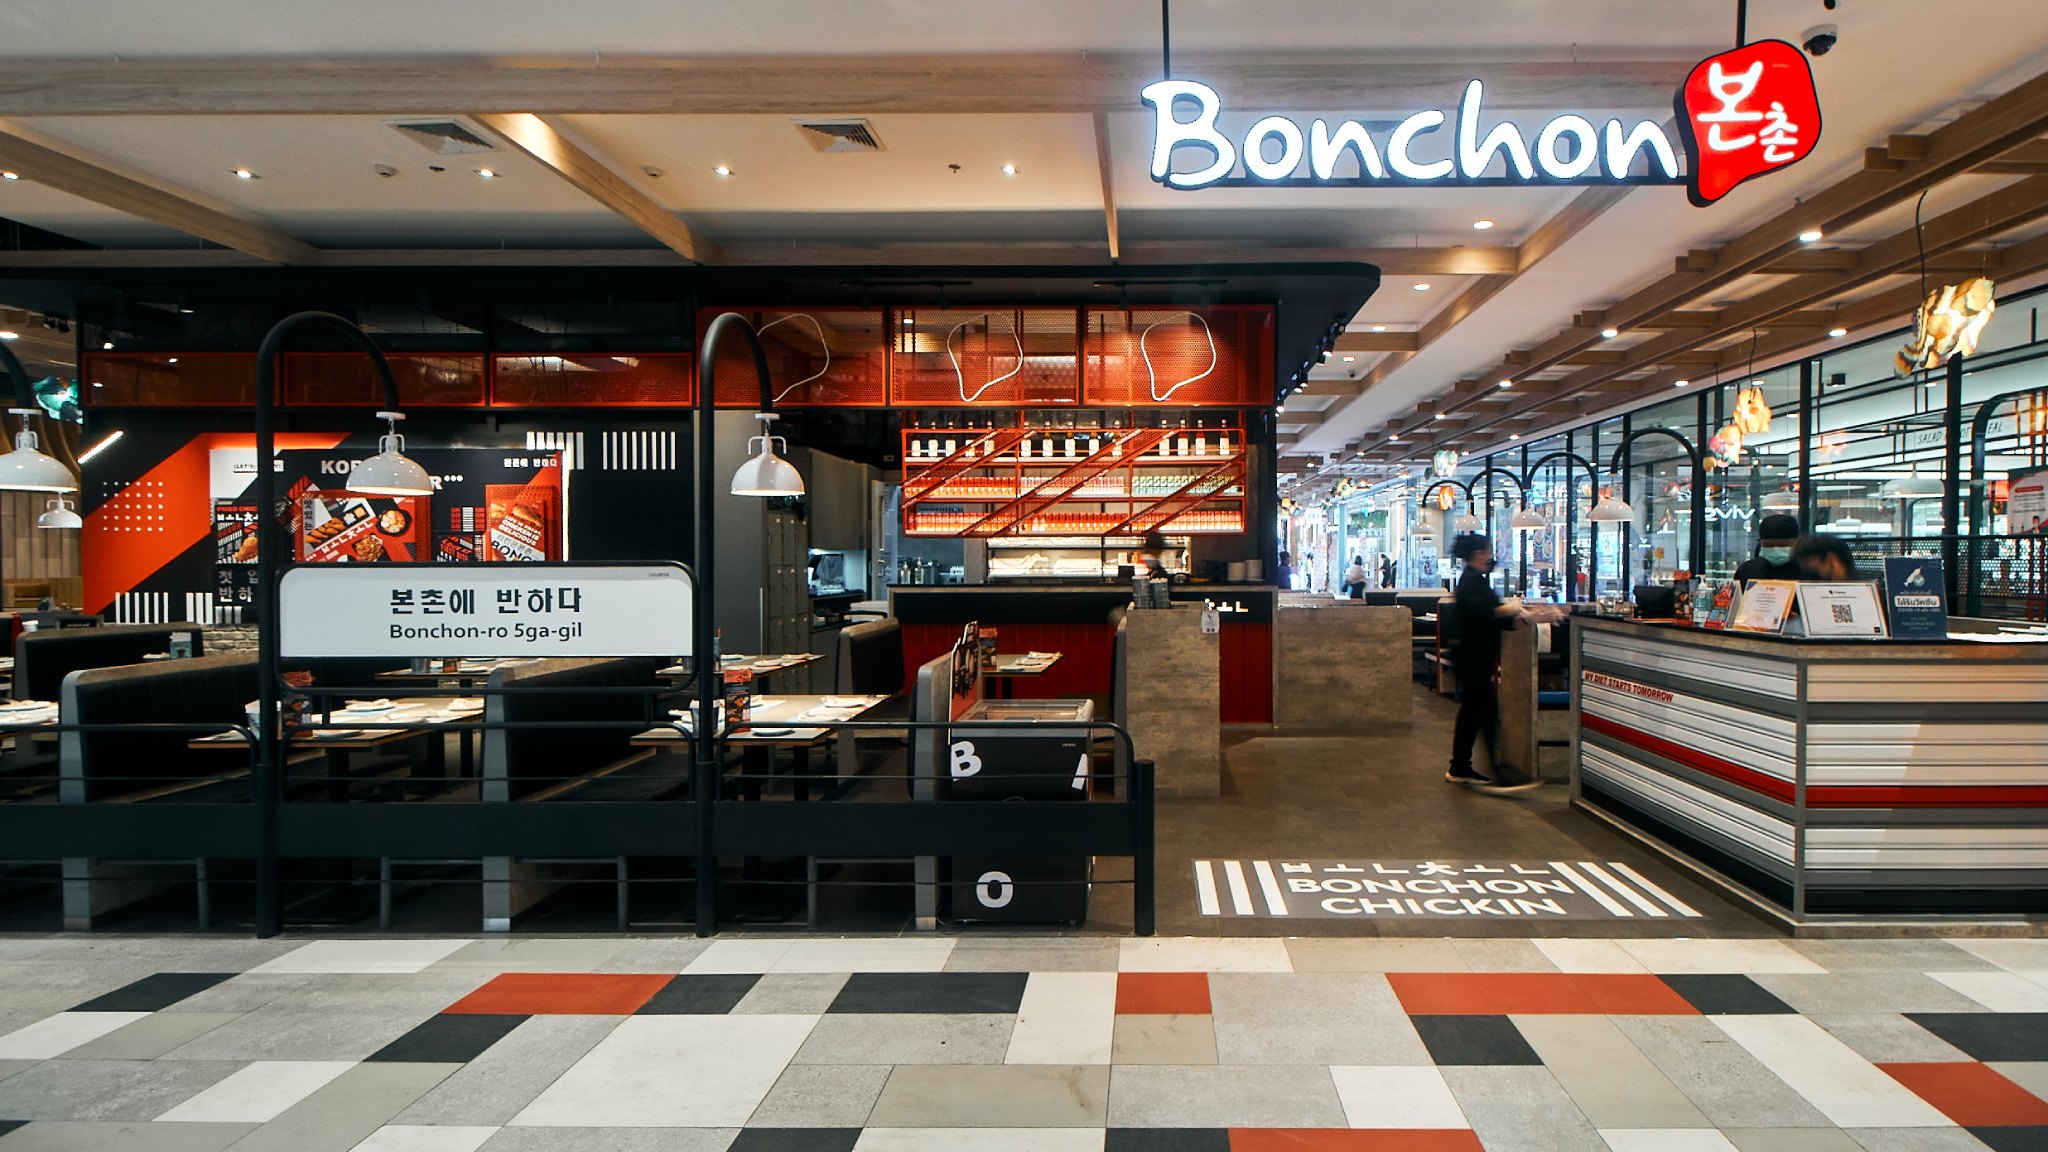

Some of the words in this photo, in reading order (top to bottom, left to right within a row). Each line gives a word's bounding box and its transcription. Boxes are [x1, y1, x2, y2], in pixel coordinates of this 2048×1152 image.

[1697, 60, 1798, 162] 본촌
[1142, 79, 1678, 184] Bonchon
[390, 589, 475, 615] 본촌에
[496, 587, 582, 614] 반하다
[390, 623, 508, 638] Bonchon-ro
[514, 622, 582, 642] 5ga-gil
[1584, 671, 1594, 681] MY
[1595, 673, 1607, 685] DIET
[1608, 678, 1632, 693] STARTS
[1633, 684, 1674, 703] TOMORROW
[1287, 878, 1575, 895] BONCHON
[1320, 898, 1567, 915] CHICKIN
